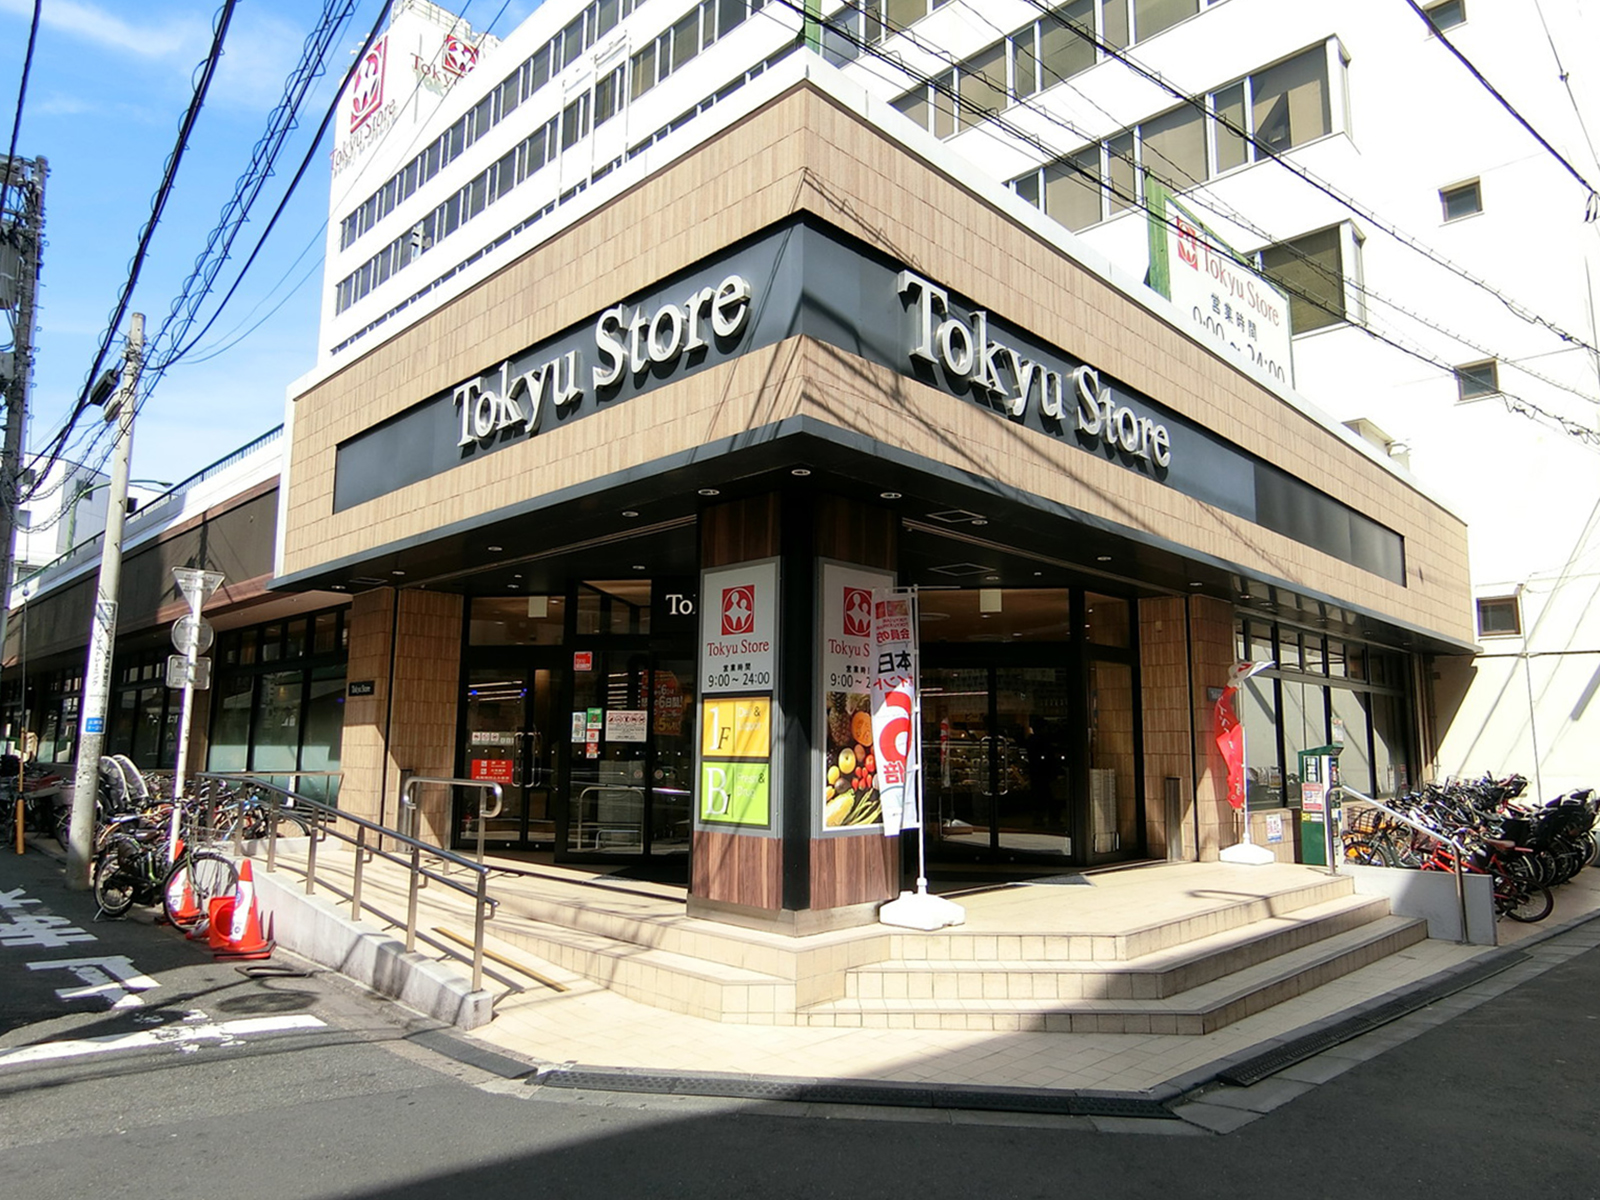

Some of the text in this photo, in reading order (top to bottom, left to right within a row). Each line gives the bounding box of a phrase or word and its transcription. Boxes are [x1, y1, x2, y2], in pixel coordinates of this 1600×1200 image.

[410, 53, 456, 87] Toky
[330, 99, 397, 170] Tokyu Store
[1202, 243, 1280, 326] Tokyu Store
[453, 274, 751, 449] Tokyu Store
[897, 269, 1171, 468] Tokyu Store
[665, 594, 696, 615] To
[707, 639, 770, 658] Tokyu Store
[828, 639, 871, 658] Tokyu S
[846, 665, 870, 674] 営業時
[753, 706, 761, 717] &
[758, 772, 766, 784] &
